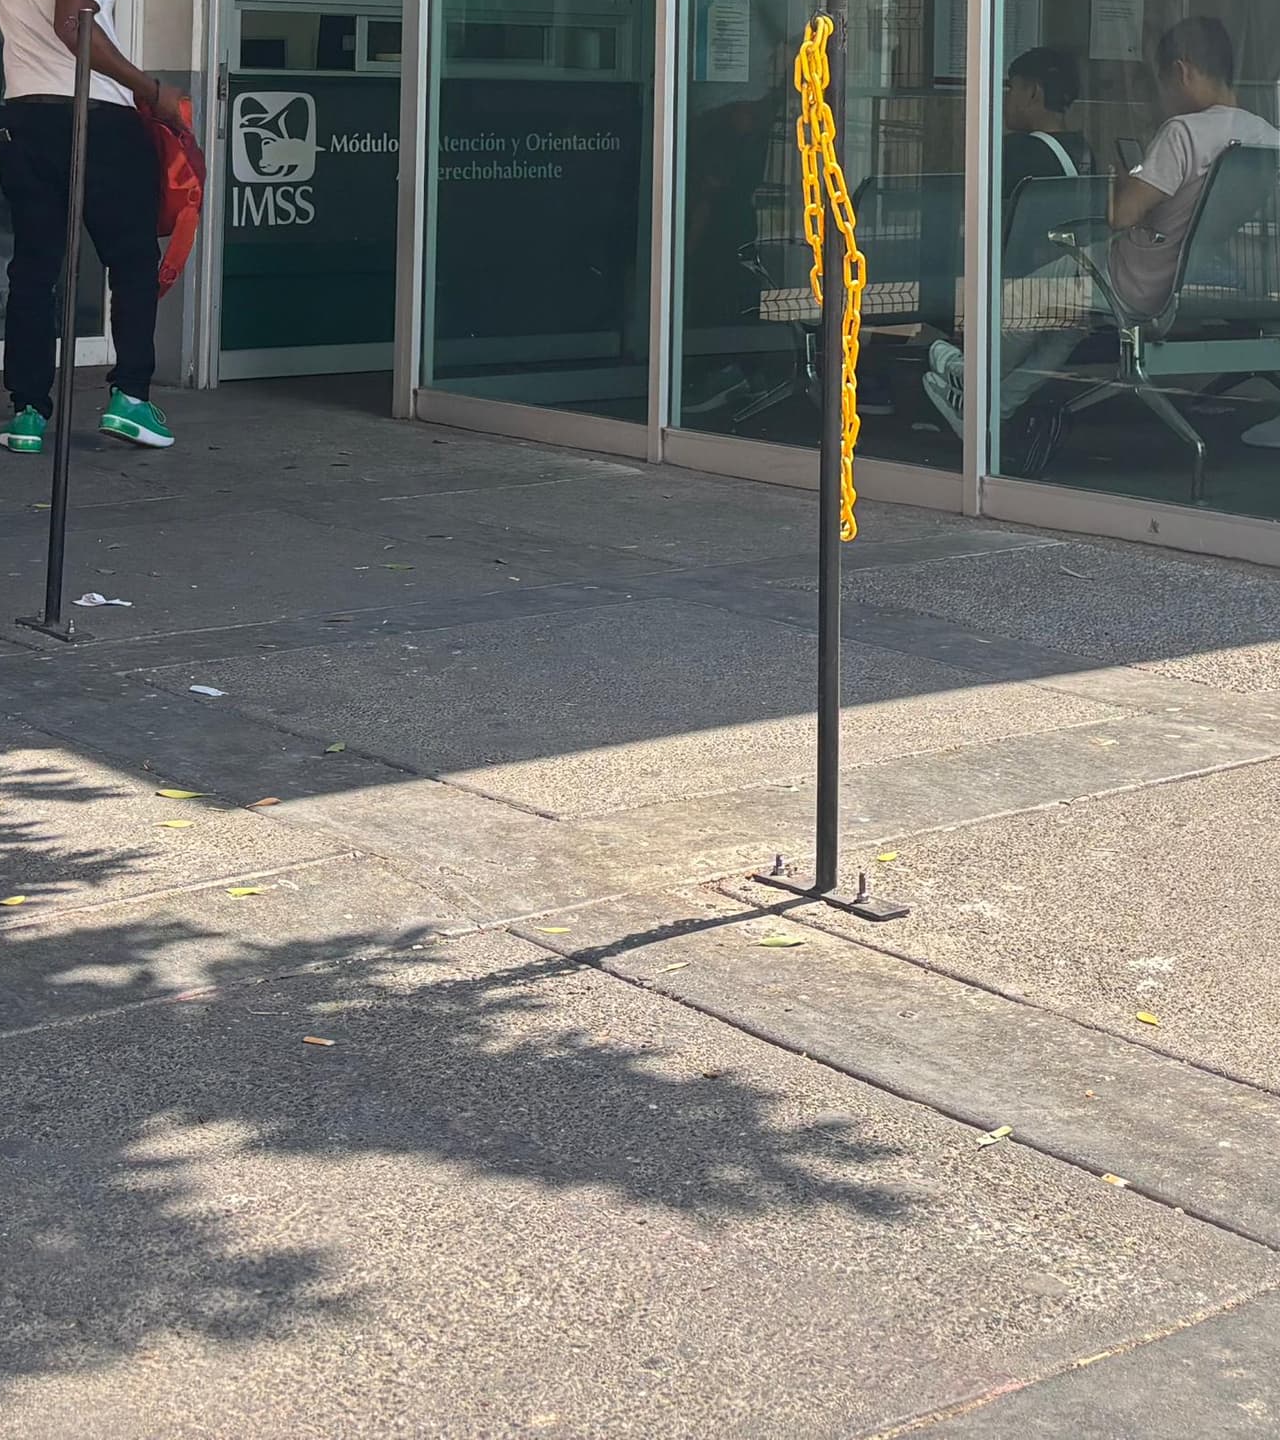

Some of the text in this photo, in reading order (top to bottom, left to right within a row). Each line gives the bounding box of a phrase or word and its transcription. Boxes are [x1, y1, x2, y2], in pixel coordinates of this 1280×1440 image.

[330, 132, 399, 154] Módulo
[511, 139, 521, 157] y
[525, 132, 621, 153] Orientación
[436, 160, 563, 181] erechohabiente
[231, 187, 316, 228] IMSS
